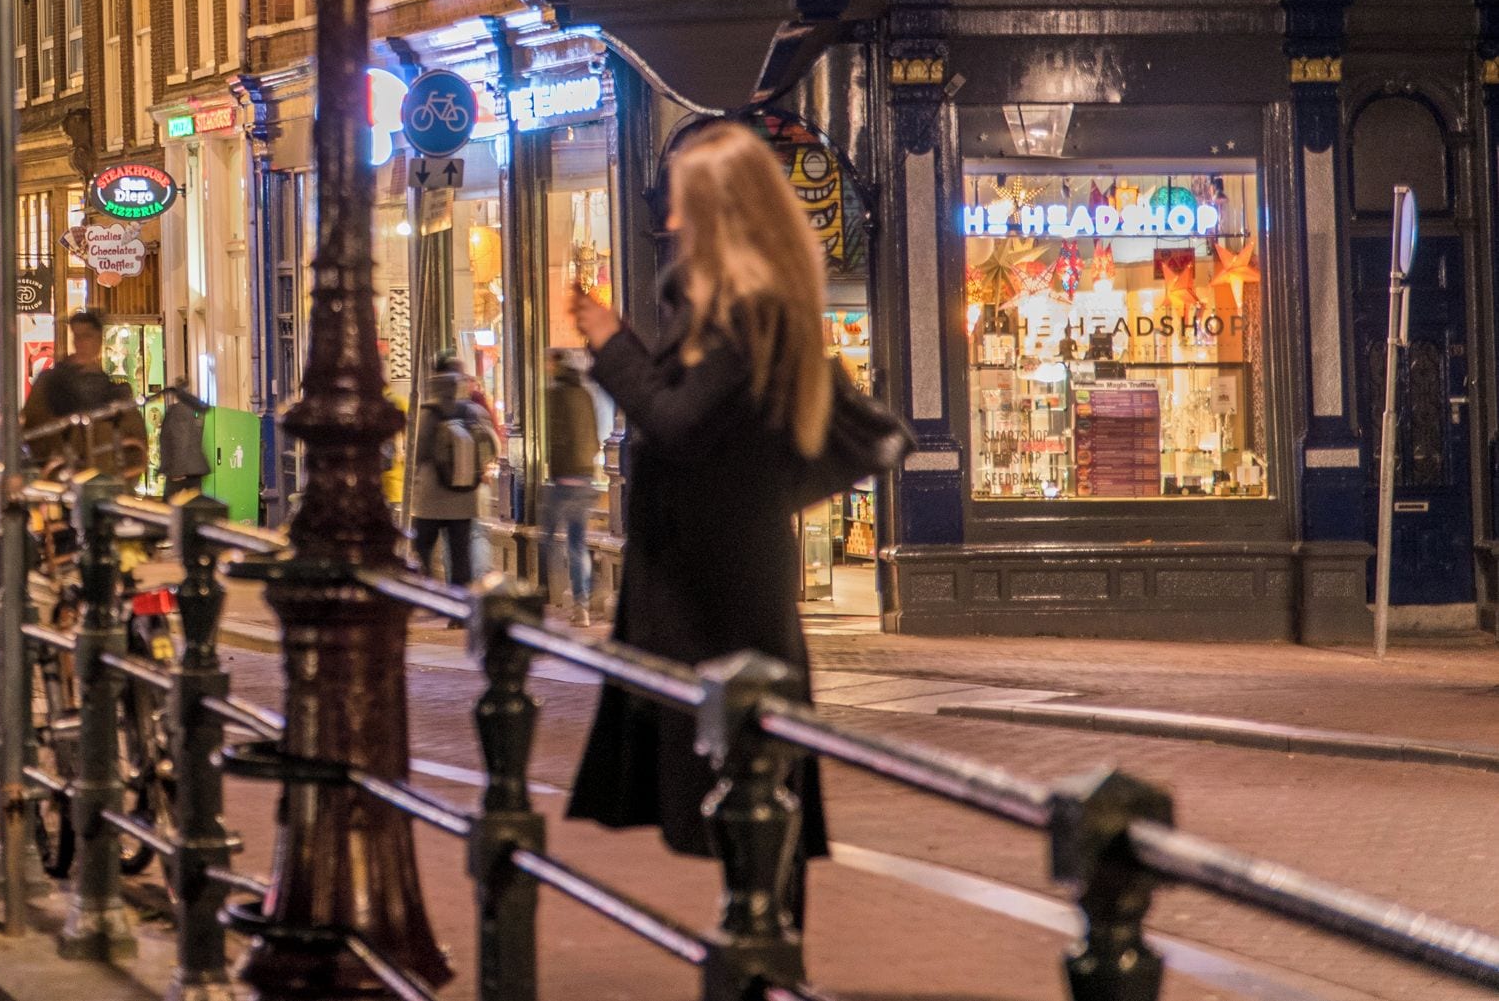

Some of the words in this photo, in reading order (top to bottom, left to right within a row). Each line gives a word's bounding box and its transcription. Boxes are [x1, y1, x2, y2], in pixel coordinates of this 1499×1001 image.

[96, 165, 171, 190] STEAKHOUSE
[114, 188, 153, 204] Diego
[105, 201, 163, 218] PIZZERIA
[963, 205, 1008, 234] HE
[1021, 204, 1218, 234] HEADSHOP
[87, 231, 122, 241] Candies
[90, 245, 137, 255] Chocolates
[99, 259, 134, 271] Waffles
[16, 279, 43, 289] NGELING
[17, 300, 43, 310] FELLOW
[1067, 316, 1246, 337] HEADSHOP
[1106, 381, 1127, 389] Magic
[983, 430, 1049, 443] SMARTSHOP
[984, 472, 1042, 487] SEEDBANK
